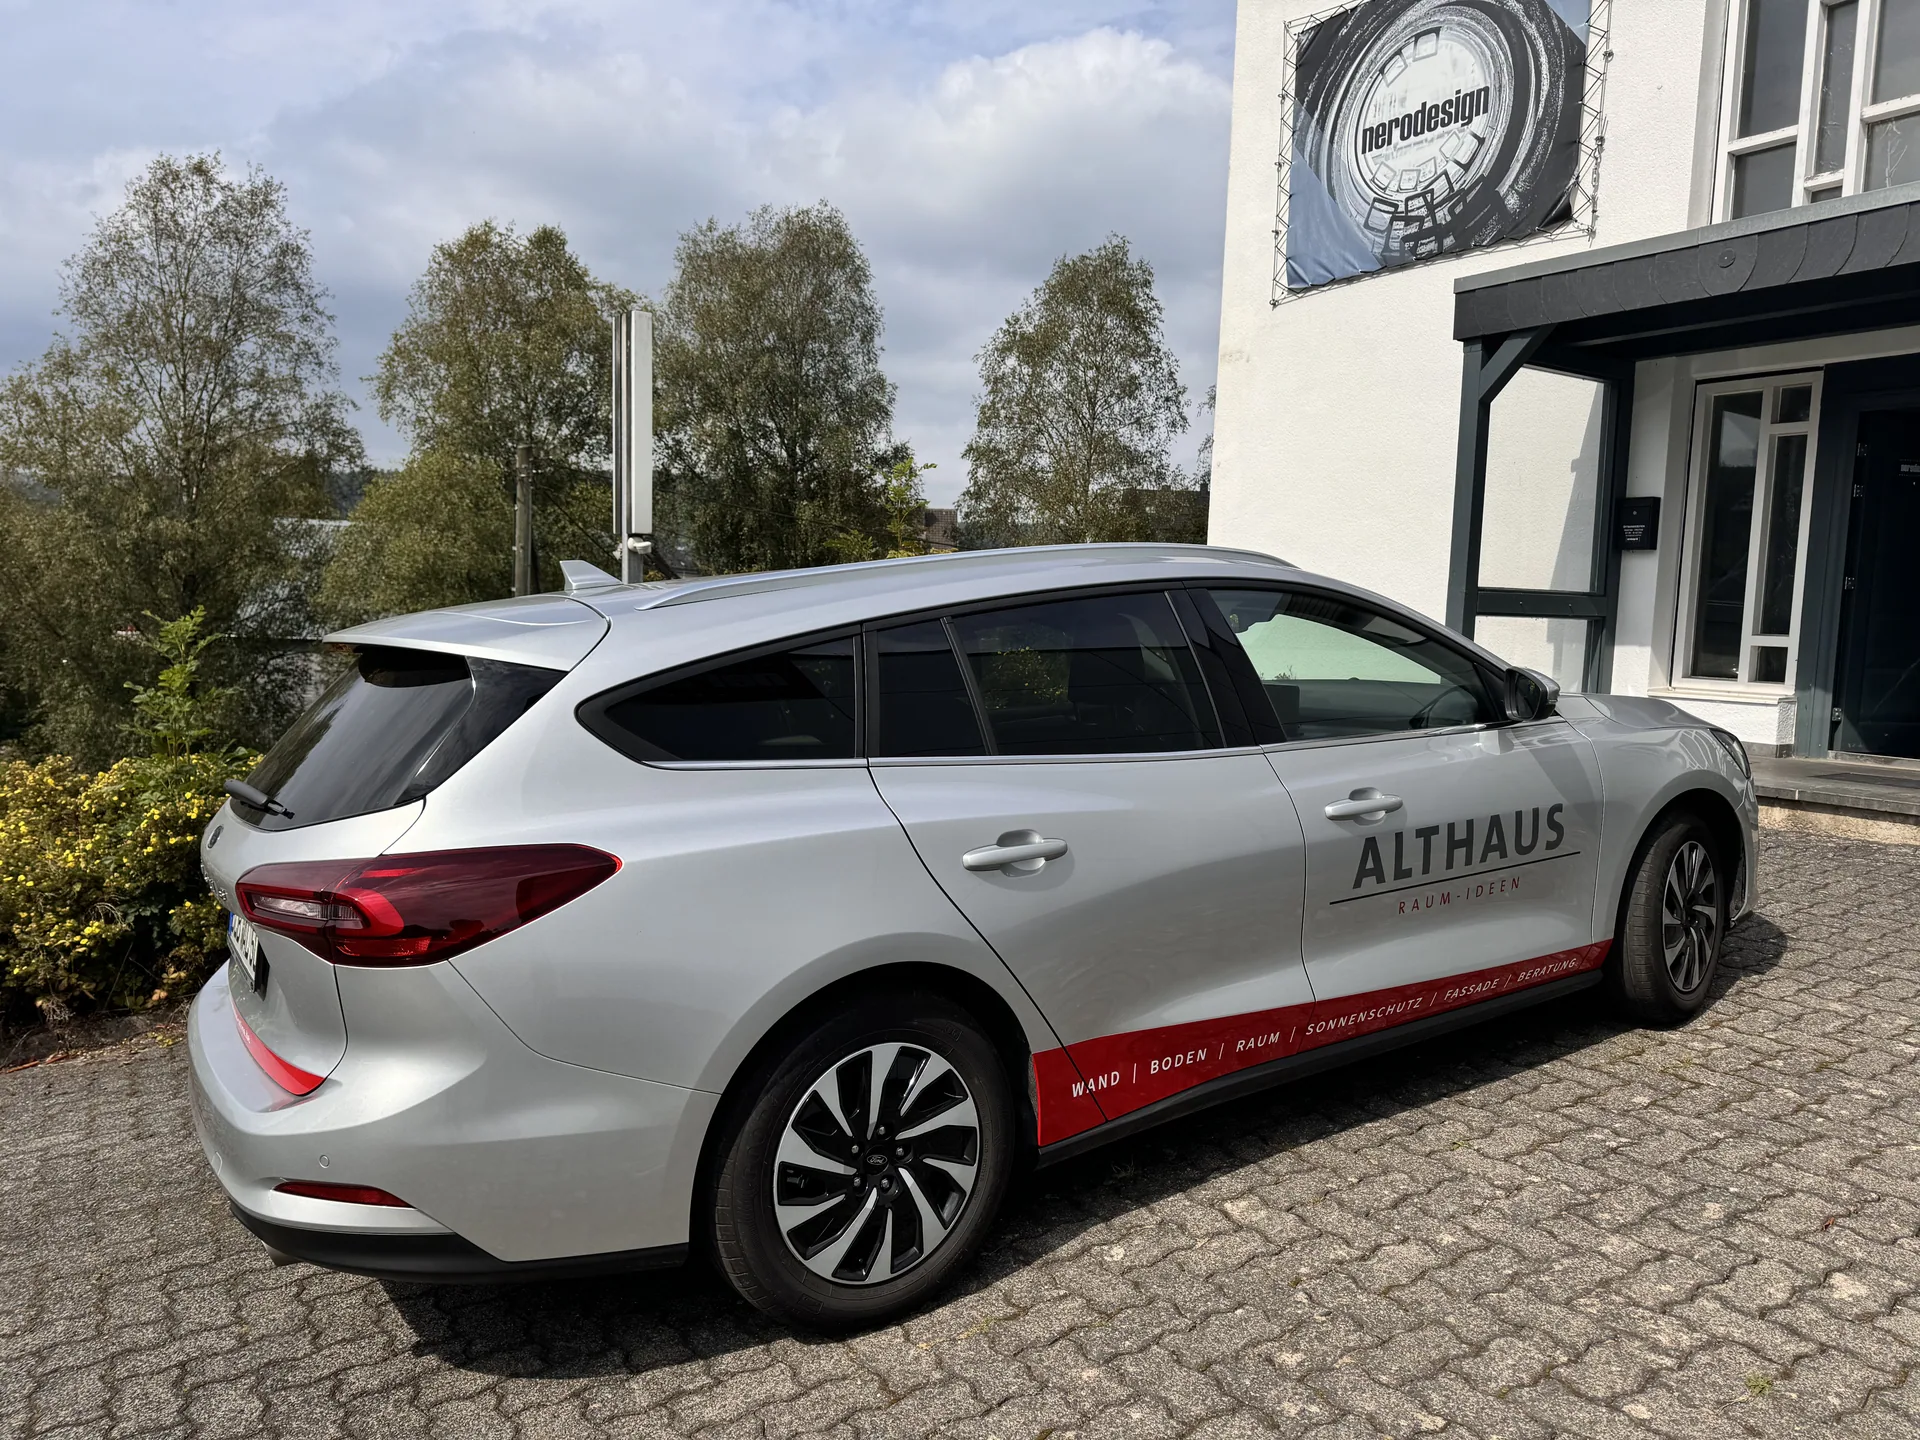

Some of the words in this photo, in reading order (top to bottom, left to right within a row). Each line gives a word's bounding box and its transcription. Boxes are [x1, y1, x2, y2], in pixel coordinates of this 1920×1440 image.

[1361, 86, 1490, 154] nerodesign
[1352, 803, 1565, 889] ALTHAUS
[1398, 876, 1520, 915] RAUM-IDEEN
[1071, 1071, 1120, 1098] WAND
[1150, 1048, 1207, 1075] BODEN
[1236, 1031, 1281, 1053] RAUM
[1305, 997, 1423, 1036] SONNENSCHUTZ
[1444, 978, 1500, 1001] FASSADE
[1517, 957, 1577, 982] BERATUNG
